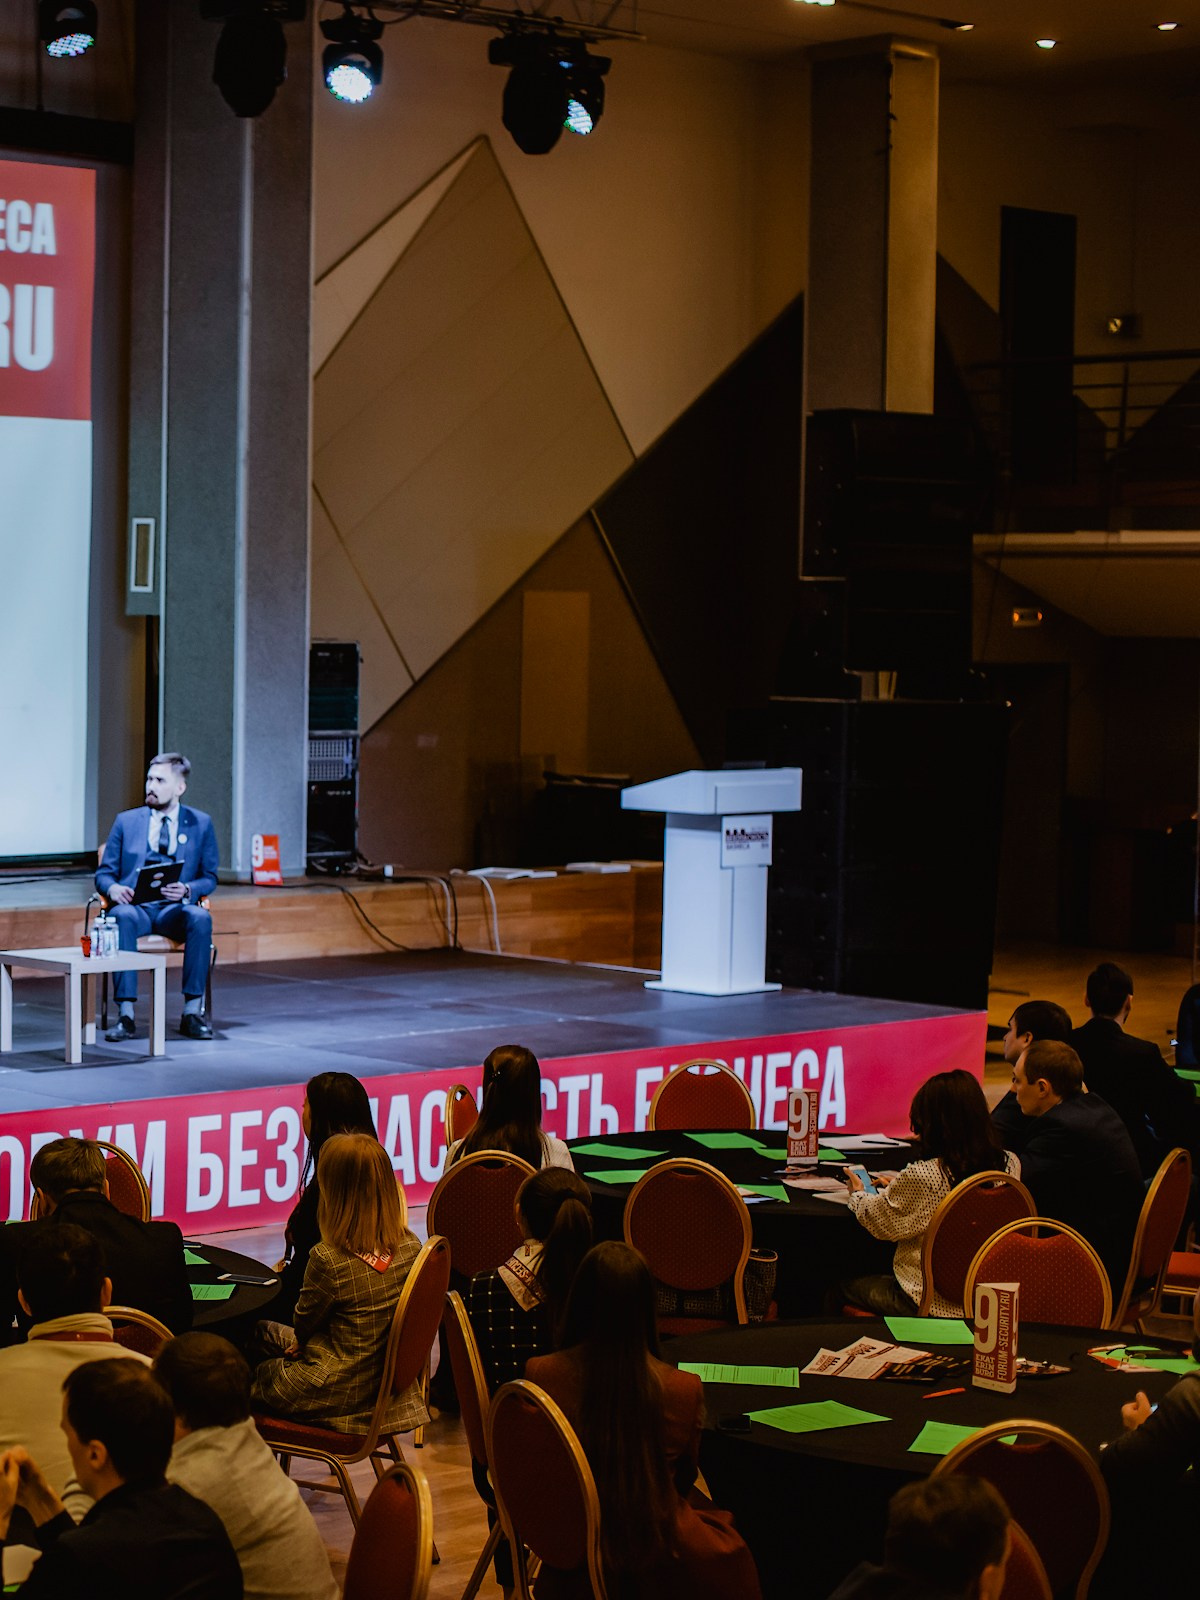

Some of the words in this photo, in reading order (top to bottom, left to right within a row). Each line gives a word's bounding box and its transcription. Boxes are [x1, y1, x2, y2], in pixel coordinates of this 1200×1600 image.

[788, 1092, 809, 1140] 9
[974, 1285, 998, 1354] 9
[997, 1292, 1010, 1380] FORUM-SECURITY.RU
